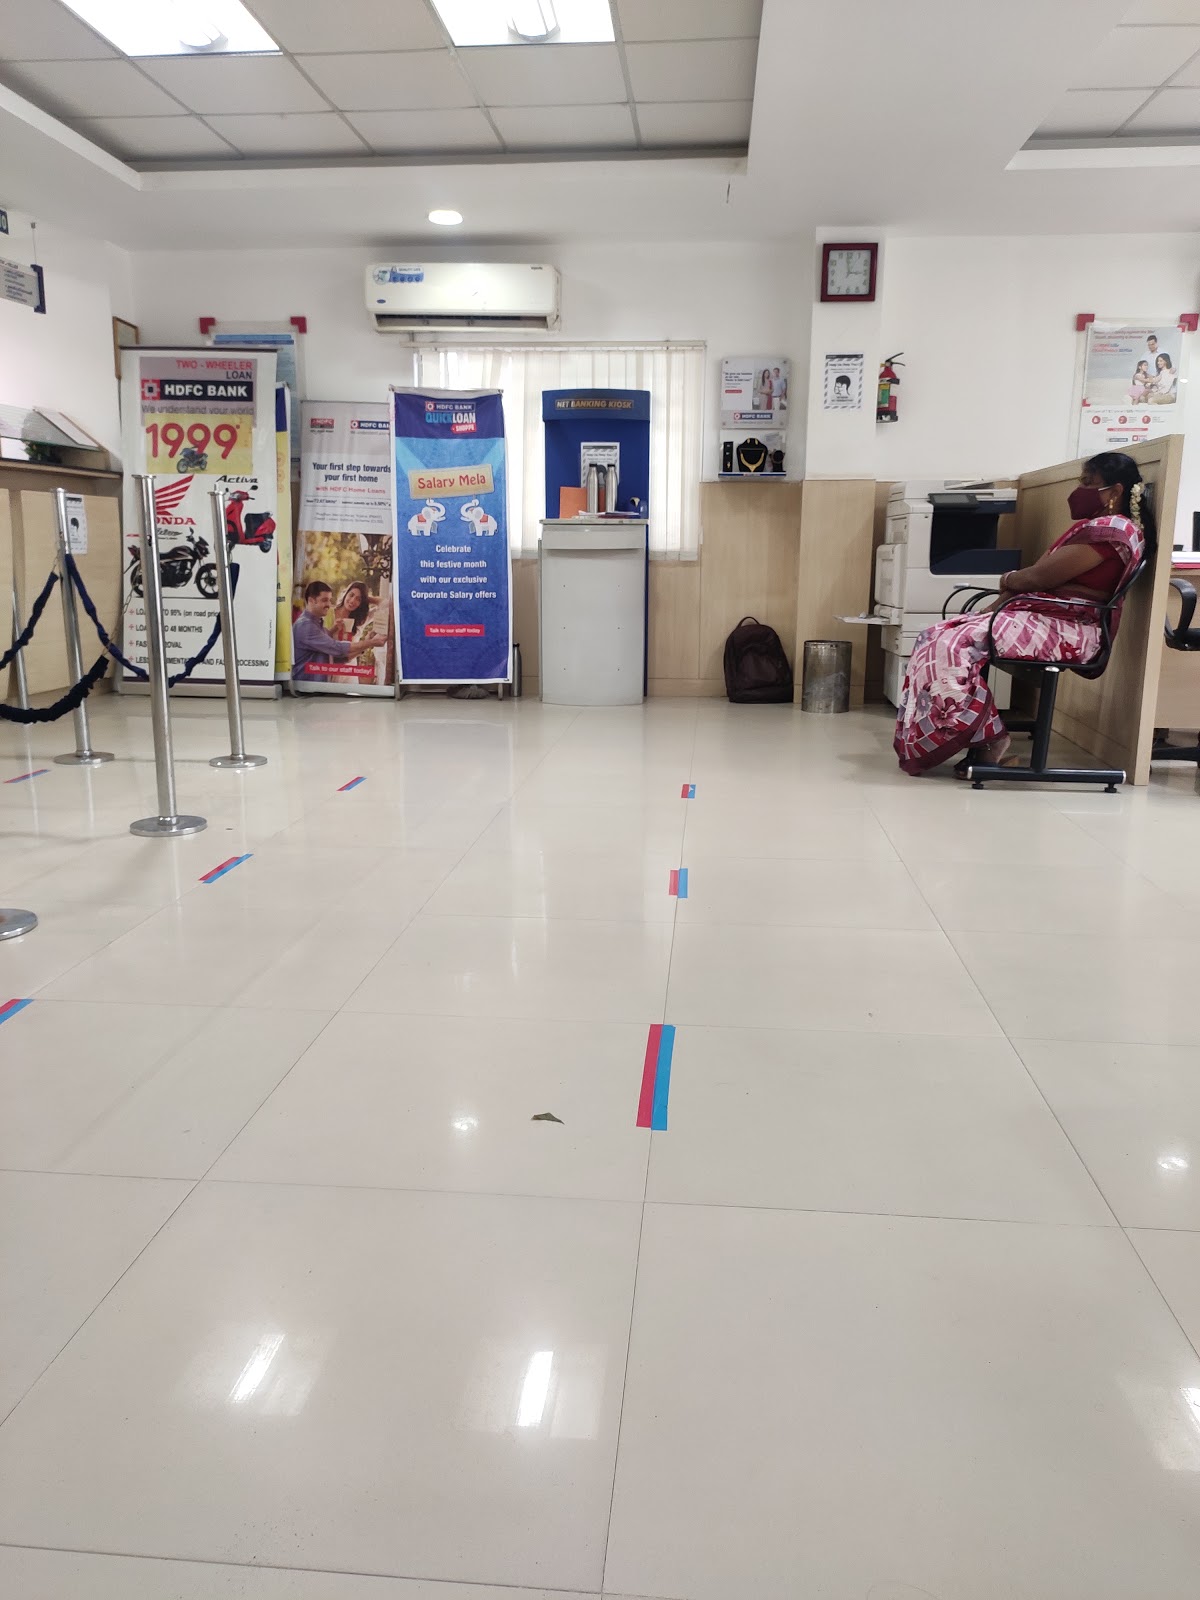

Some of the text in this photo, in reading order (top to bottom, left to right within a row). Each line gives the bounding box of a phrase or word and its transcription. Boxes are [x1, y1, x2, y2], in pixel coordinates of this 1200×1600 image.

[176, 360, 197, 369] TWO
[206, 361, 252, 371] WHEELER
[226, 371, 252, 380] LOAN
[165, 384, 247, 397] HDFC BANK
[556, 400, 633, 409] NET BANKING KIOSK
[312, 462, 391, 473] Your first step towards
[216, 475, 258, 484] Activa
[324, 474, 340, 482] your
[359, 474, 378, 483] home
[418, 473, 486, 490] Salary Mela
[436, 544, 471, 553] Celebrate
[420, 560, 487, 568] this festive month
[420, 575, 488, 584] with our exclusive
[411, 590, 497, 600] Corporate Salary offers
[178, 625, 203, 633] MONTHS
[237, 659, 269, 667] ROCESSING
